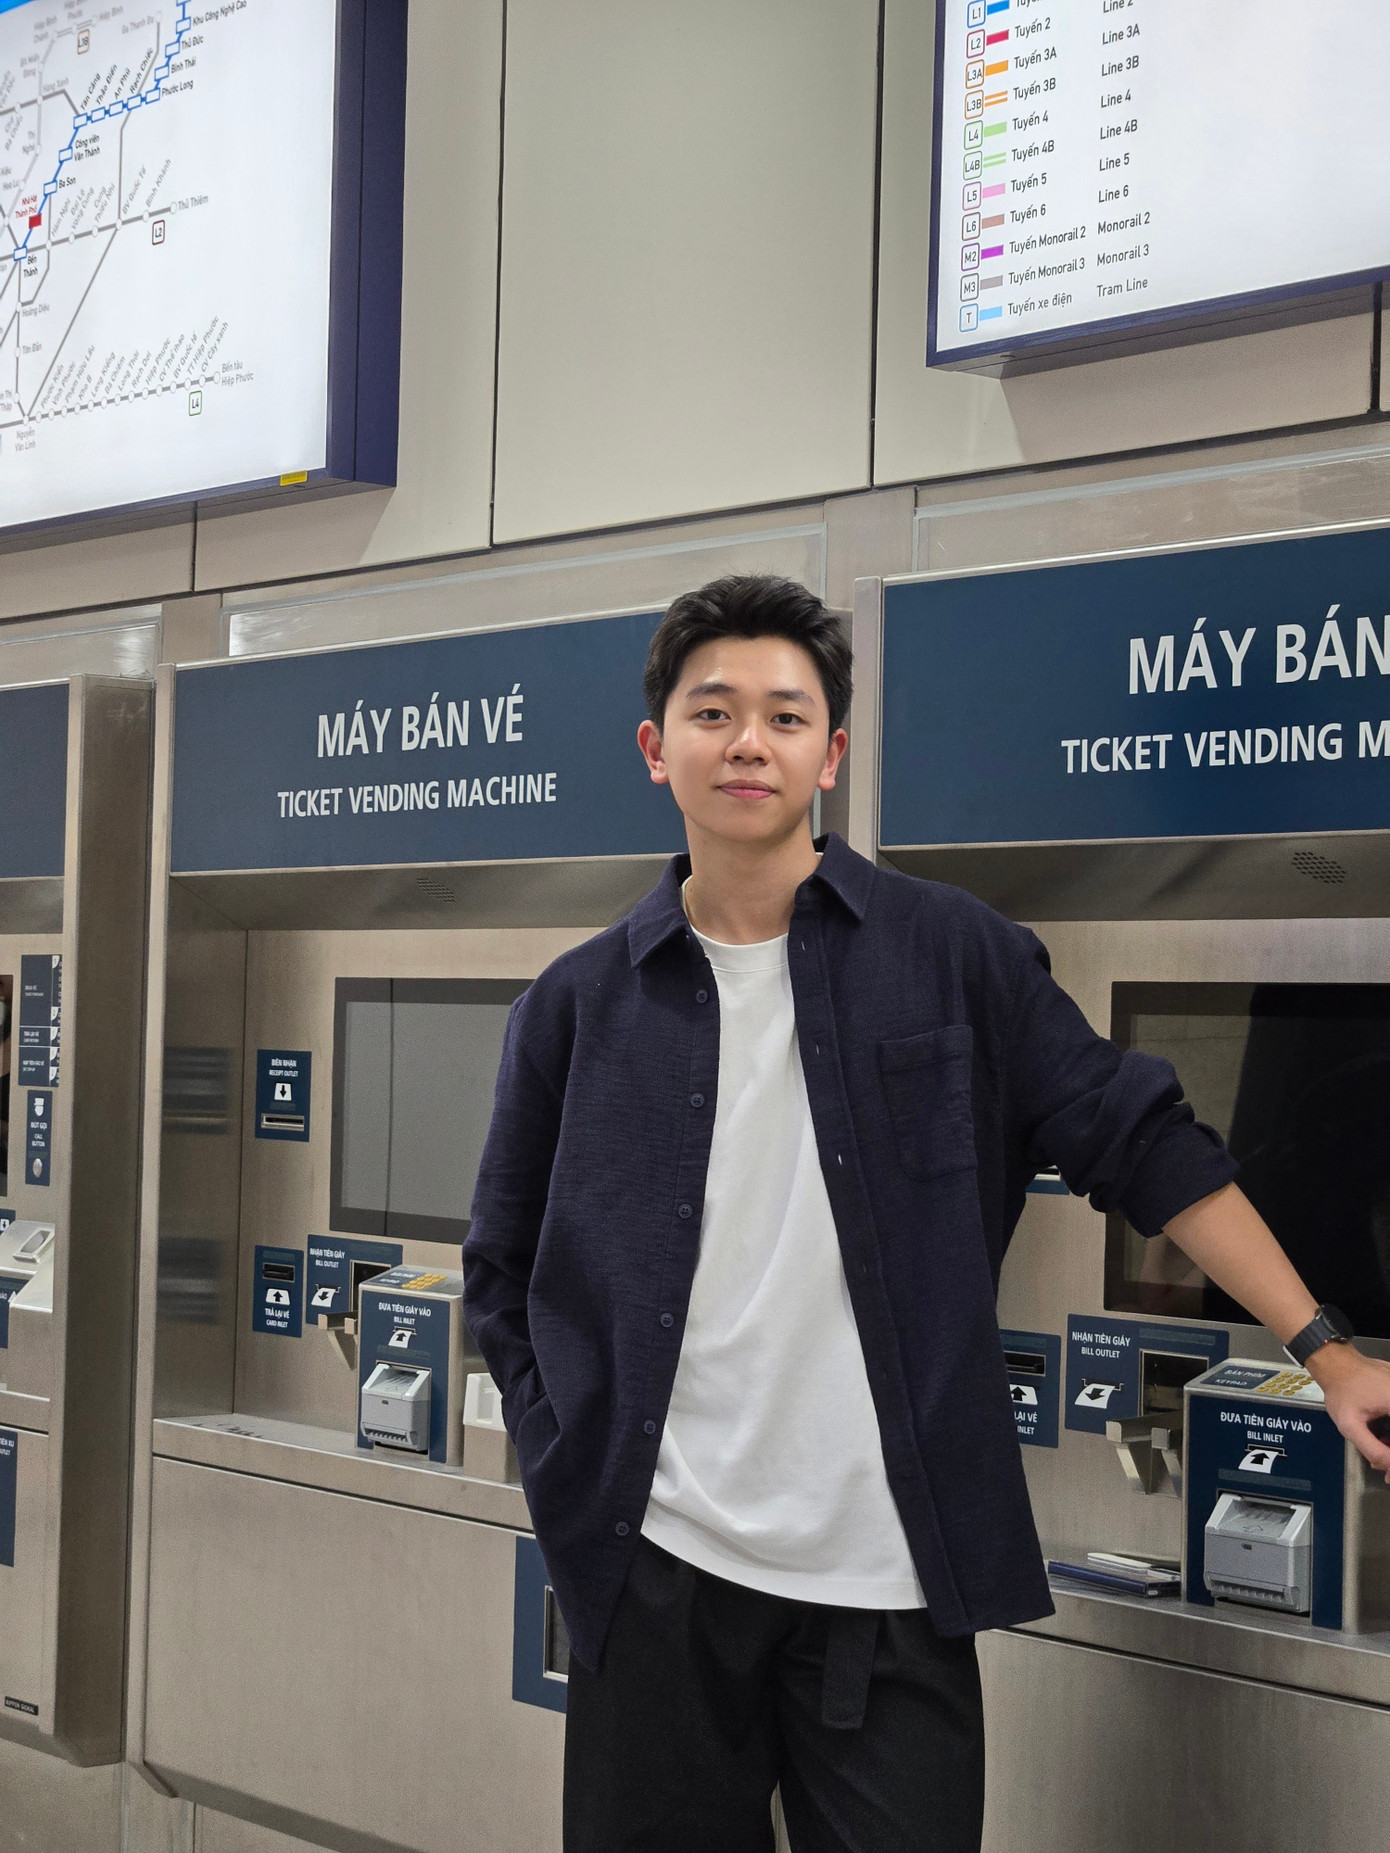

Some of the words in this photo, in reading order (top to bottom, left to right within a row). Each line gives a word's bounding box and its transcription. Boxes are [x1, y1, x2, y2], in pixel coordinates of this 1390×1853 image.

[192, 16, 204, 26] Khu
[205, 10, 218, 21] Công
[236, 0, 247, 10] Cao
[972, 7, 980, 20] L1
[1103, 0, 1124, 14] Line
[1015, 18, 1042, 38] Tuyến
[1044, 17, 1051, 30] 2
[1102, 30, 1124, 45] Line
[1126, 24, 1140, 38] 3A
[182, 39, 191, 50] Thủ
[970, 38, 980, 50] L2
[171, 62, 184, 74] Bình
[184, 56, 196, 68] Thái
[1014, 50, 1042, 70] Tuyến
[1044, 46, 1057, 61] 3A
[1102, 62, 1123, 76] Line
[1126, 55, 1140, 70] 3B
[114, 88, 122, 100] An
[120, 68, 131, 86] Phú
[968, 68, 982, 81] L3A
[180, 80, 193, 92] Long
[1013, 80, 1040, 100] Tuyến
[1044, 78, 1056, 92] 3B
[80, 96, 90, 110] Tân
[966, 98, 982, 112] L3B
[1101, 94, 1122, 108] Line
[1125, 88, 1132, 102] 4
[1012, 111, 1040, 131] Tuyến
[1042, 110, 1048, 122] 4
[1100, 126, 1122, 140] Line
[1124, 119, 1138, 134] 4B
[75, 138, 88, 150] Công
[89, 134, 100, 145] viên
[968, 129, 978, 142] L4
[74, 151, 85, 162] Văn
[1012, 142, 1039, 162] Tuyến
[1042, 140, 1054, 154] 4B
[965, 160, 980, 172] L4B
[1100, 157, 1121, 172] Line
[1124, 152, 1130, 166] 5
[59, 179, 66, 188] Ba
[66, 176, 76, 186] Son
[146, 188, 158, 208] Bình
[156, 158, 172, 186] Khánh
[1011, 173, 1038, 193] Tuyến
[1041, 172, 1047, 185] 5
[967, 190, 978, 202] L5
[1098, 188, 1120, 203] Line
[1123, 184, 1129, 198] 6
[1010, 204, 1038, 224] Tuyến
[1040, 204, 1046, 216] 6
[1098, 214, 1142, 235] Monorail
[1144, 212, 1150, 224] 2
[155, 227, 162, 238] L2
[966, 221, 976, 232] L6
[1009, 235, 1036, 254] Tuyến
[1039, 228, 1078, 247] Monorail
[1080, 226, 1086, 238] 2
[964, 251, 976, 264] M2
[1097, 246, 1140, 266] Monorail
[1144, 244, 1149, 256] 3
[1008, 266, 1036, 286] Tuyến
[1038, 259, 1078, 278] Monorail
[1080, 257, 1084, 270] 3
[964, 282, 976, 294] M3
[1097, 282, 1122, 298] Tram
[1126, 278, 1148, 292] Line
[1008, 297, 1035, 316] Tuyến
[1038, 299, 1048, 310] xe
[1052, 292, 1072, 308] điện
[966, 312, 972, 324] T
[192, 398, 199, 408] L4
[1129, 616, 1256, 695] MÁY
[1276, 604, 1390, 684] BÁN
[318, 700, 392, 758] MÁY
[402, 691, 470, 751] BÁN
[480, 683, 524, 744] VÉ
[1061, 734, 1173, 774] TICKET
[1184, 722, 1342, 768] VENDING
[277, 788, 343, 818] TICKET
[348, 780, 440, 814] VENDING
[447, 772, 557, 808] MACHINE
[1072, 1331, 1093, 1344] NHẬN
[1082, 1346, 1094, 1356] BILL
[1096, 1348, 1120, 1358] OUTLET
[1028, 1412, 1038, 1423] VÉ
[1220, 1411, 1242, 1424] ĐƯA
[1290, 1420, 1312, 1432] VÀO
[1017, 1426, 1034, 1435] INLET
[1247, 1430, 1262, 1440] BILL
[1264, 1432, 1284, 1443] INLET
